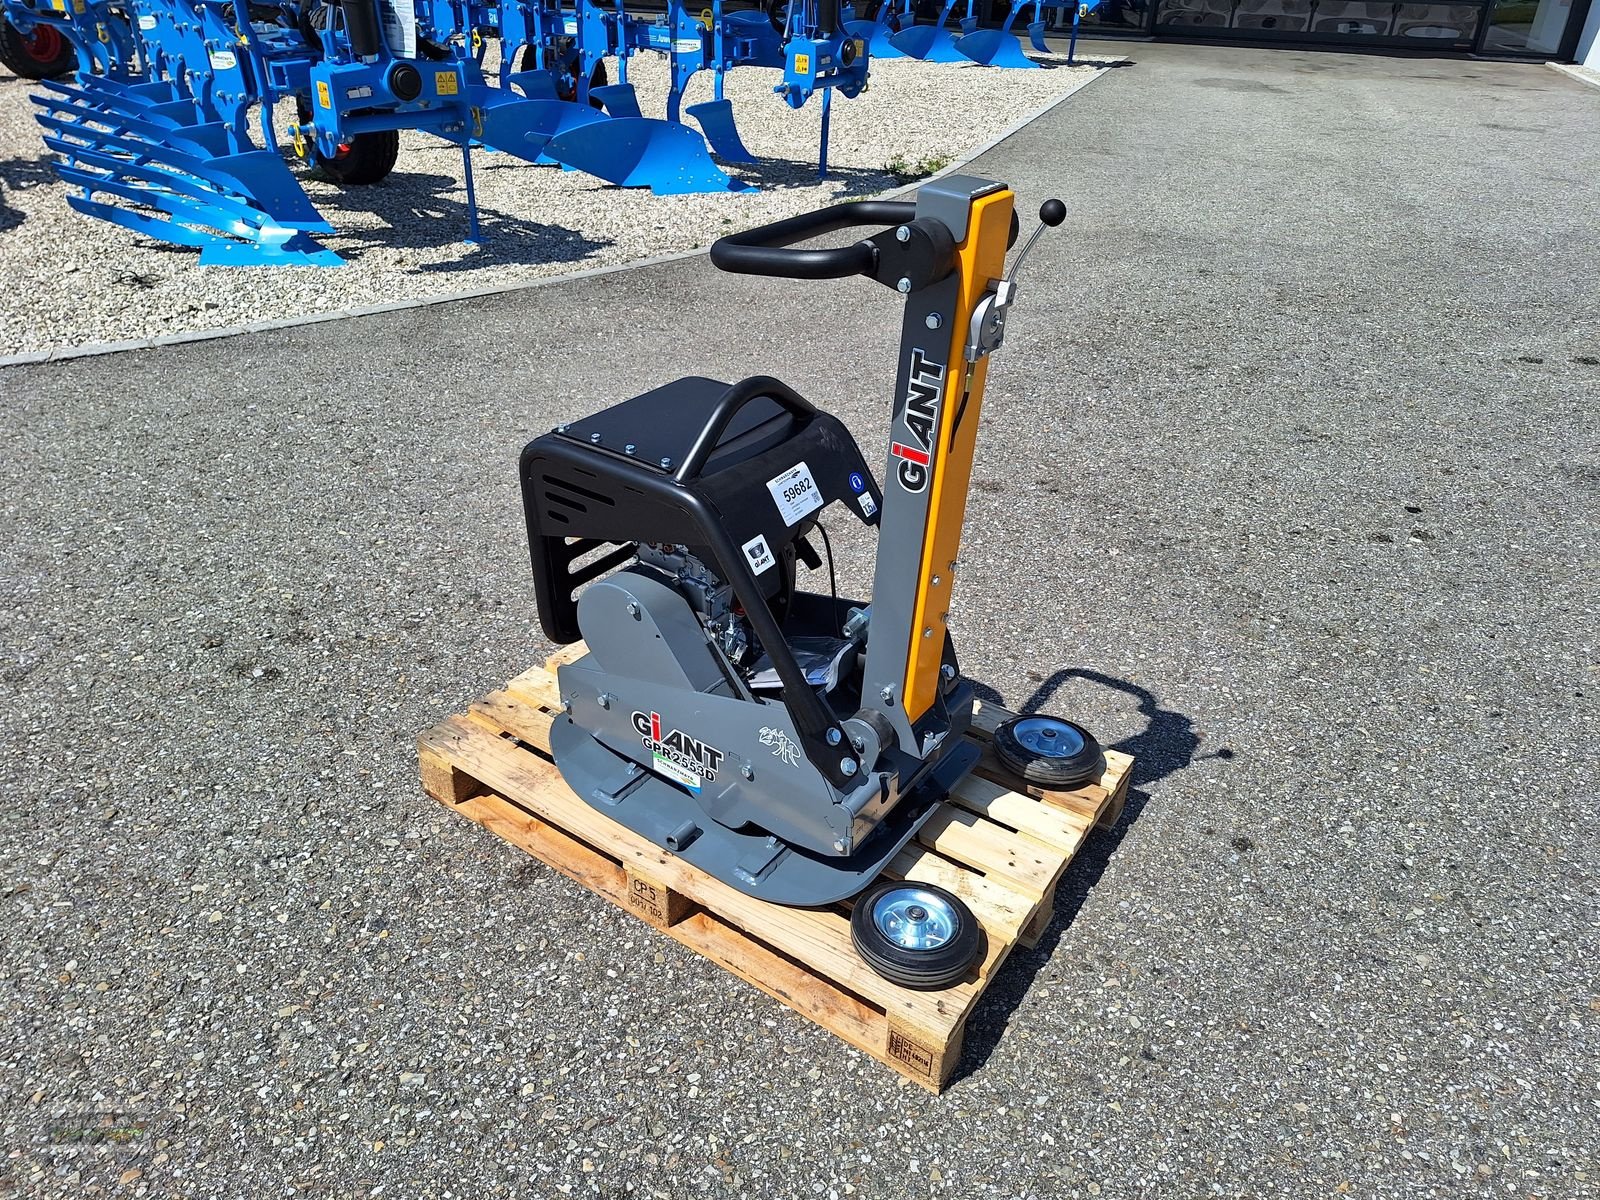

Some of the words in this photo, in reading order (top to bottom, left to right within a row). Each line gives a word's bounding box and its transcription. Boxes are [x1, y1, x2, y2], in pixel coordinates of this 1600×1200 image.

[783, 477, 812, 502] 59682
[642, 736, 715, 782] GPR2553D
[634, 879, 647, 893] CP
[648, 886, 656, 901] 5
